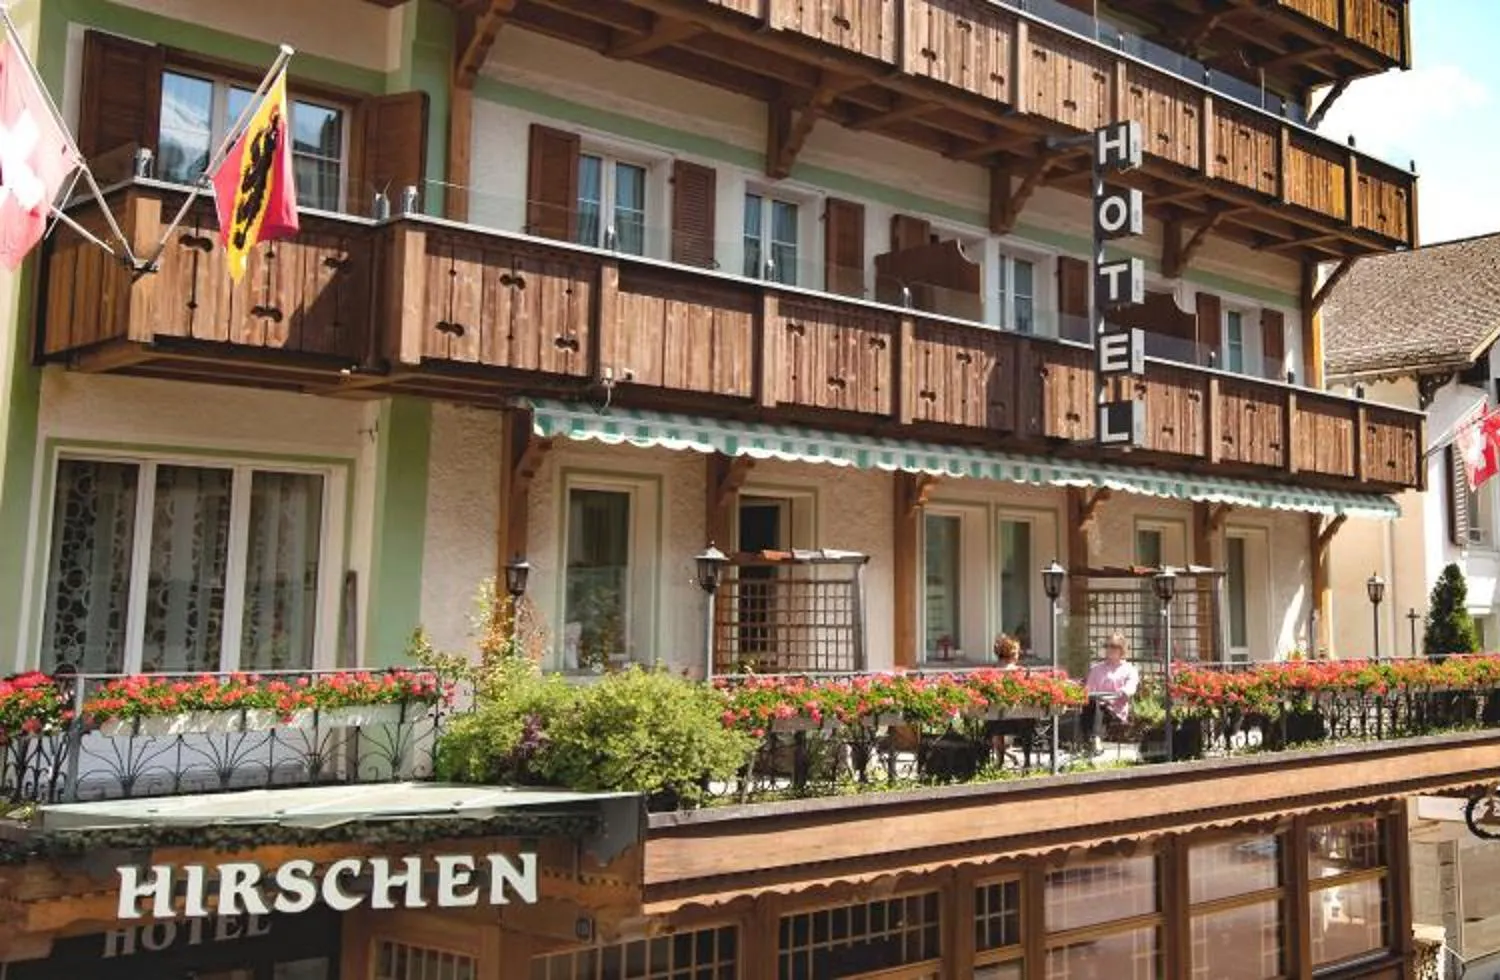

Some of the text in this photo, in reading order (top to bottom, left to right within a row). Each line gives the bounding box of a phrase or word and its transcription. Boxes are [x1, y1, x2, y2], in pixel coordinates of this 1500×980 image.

[1099, 125, 1130, 441] HOTEL
[116, 852, 538, 920] HIRSCHEN
[103, 914, 272, 958] HOTEL
